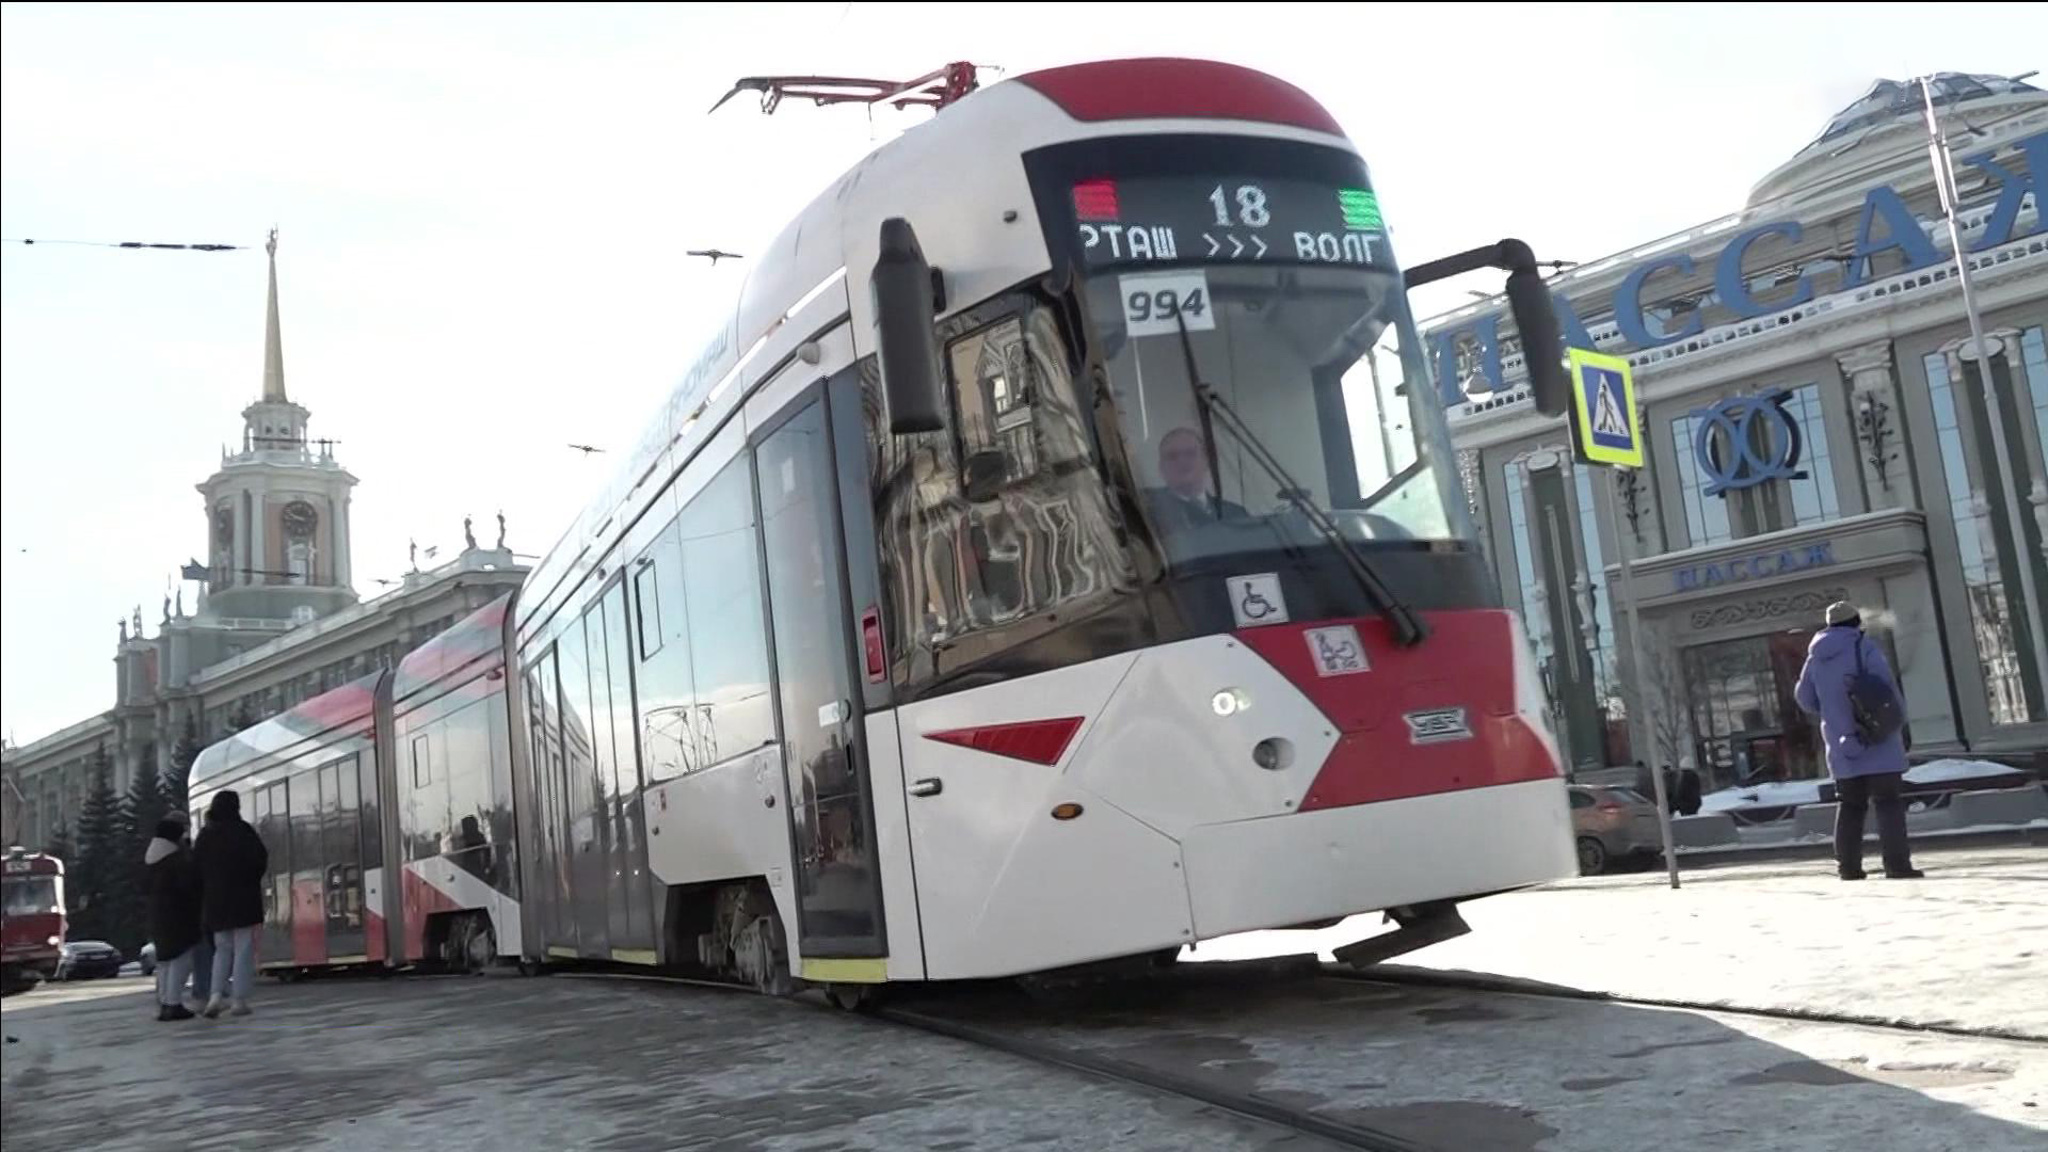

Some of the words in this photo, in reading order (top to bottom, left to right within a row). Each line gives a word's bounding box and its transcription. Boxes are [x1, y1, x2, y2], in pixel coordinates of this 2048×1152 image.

[1208, 184, 1271, 228] 18
[1293, 231, 1382, 264] ВОЛГ
[1128, 287, 1205, 322] 994
[1672, 540, 1838, 594] ПАССАЖ
